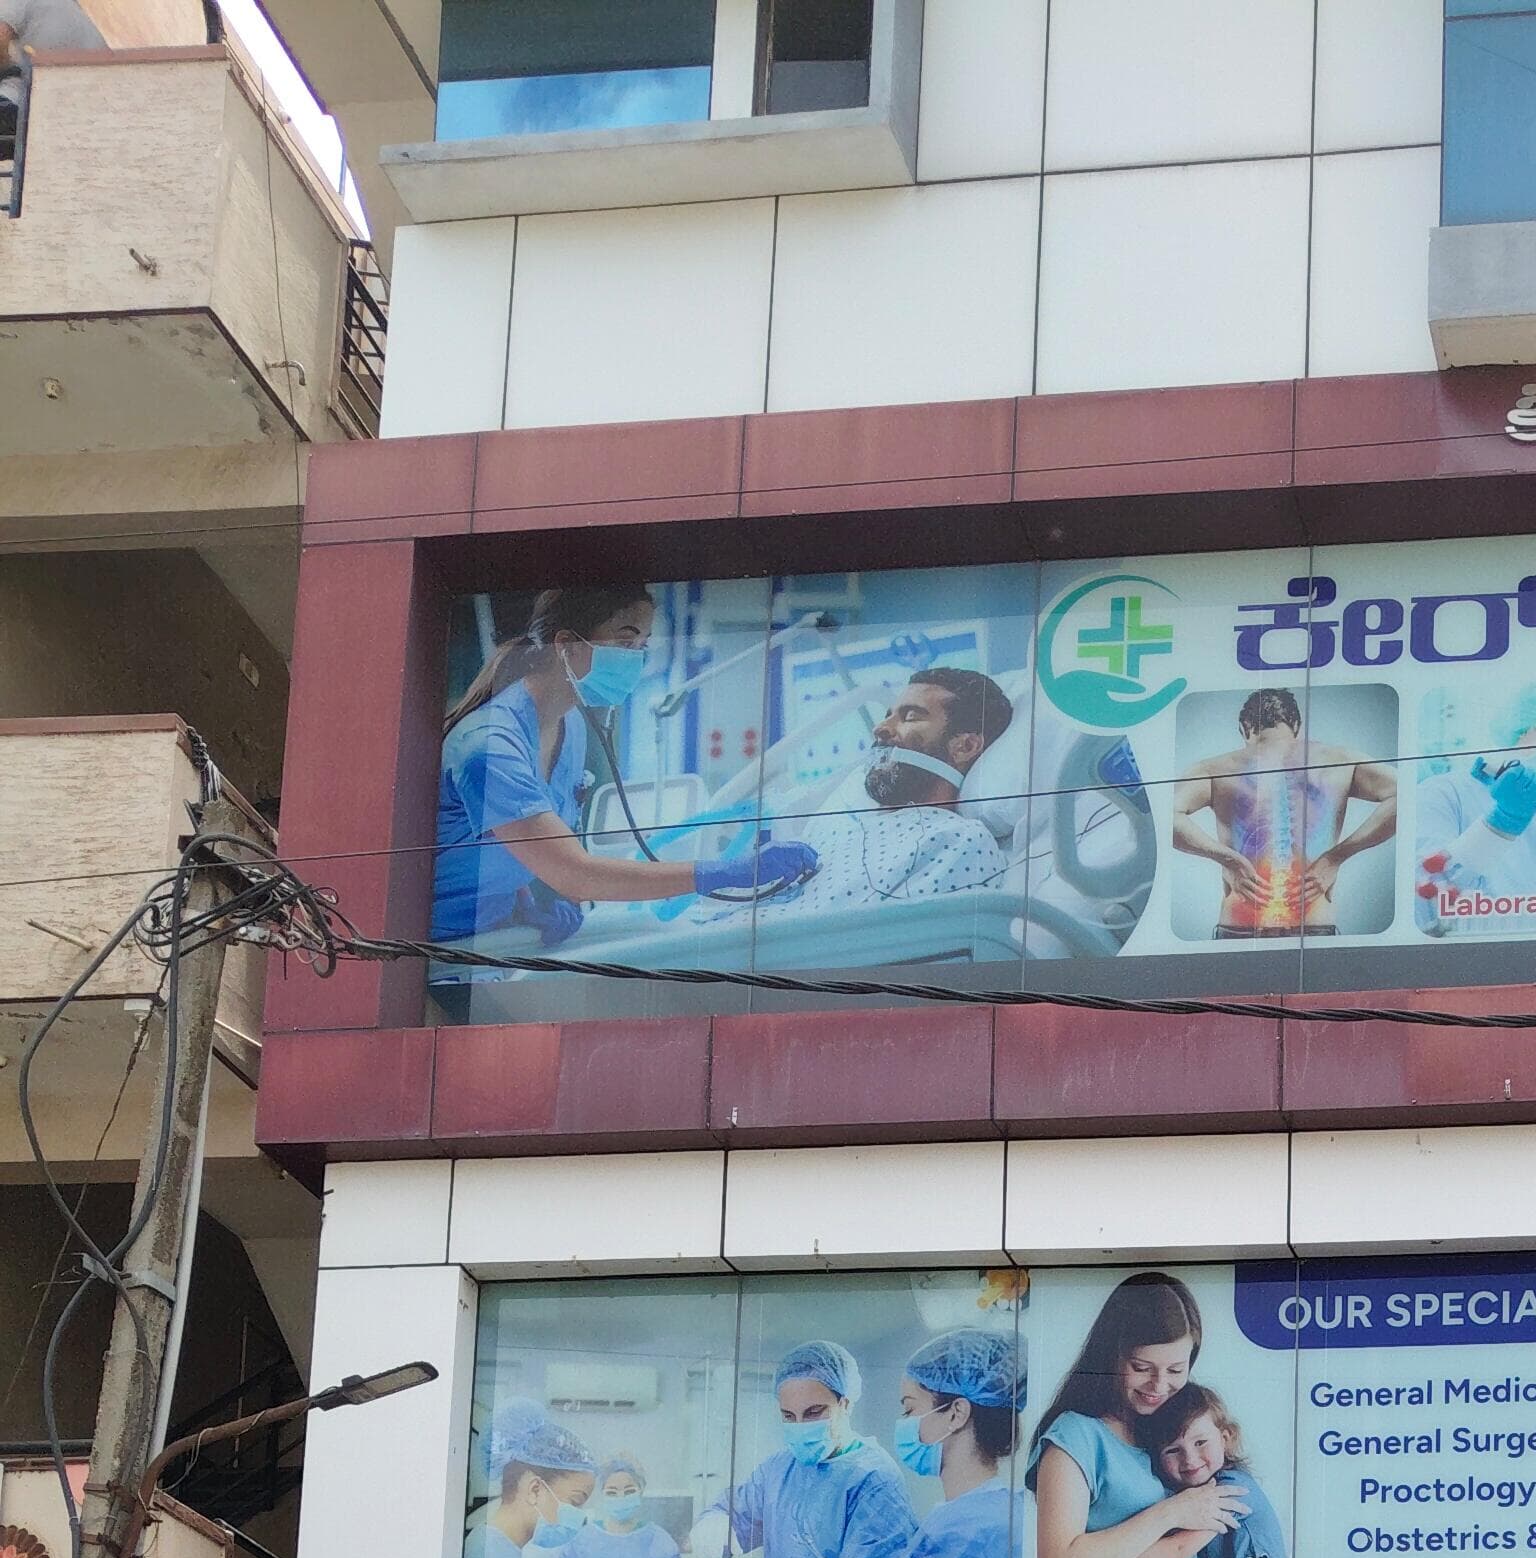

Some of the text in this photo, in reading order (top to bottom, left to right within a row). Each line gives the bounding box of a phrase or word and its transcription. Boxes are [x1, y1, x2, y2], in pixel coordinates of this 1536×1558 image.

[1277, 1295, 1373, 1330] OUR
[1309, 1380, 1434, 1408] General
[1318, 1428, 1442, 1456] General
[1360, 1476, 1536, 1507] Proctology
[1346, 1524, 1517, 1553] Obstetrics
